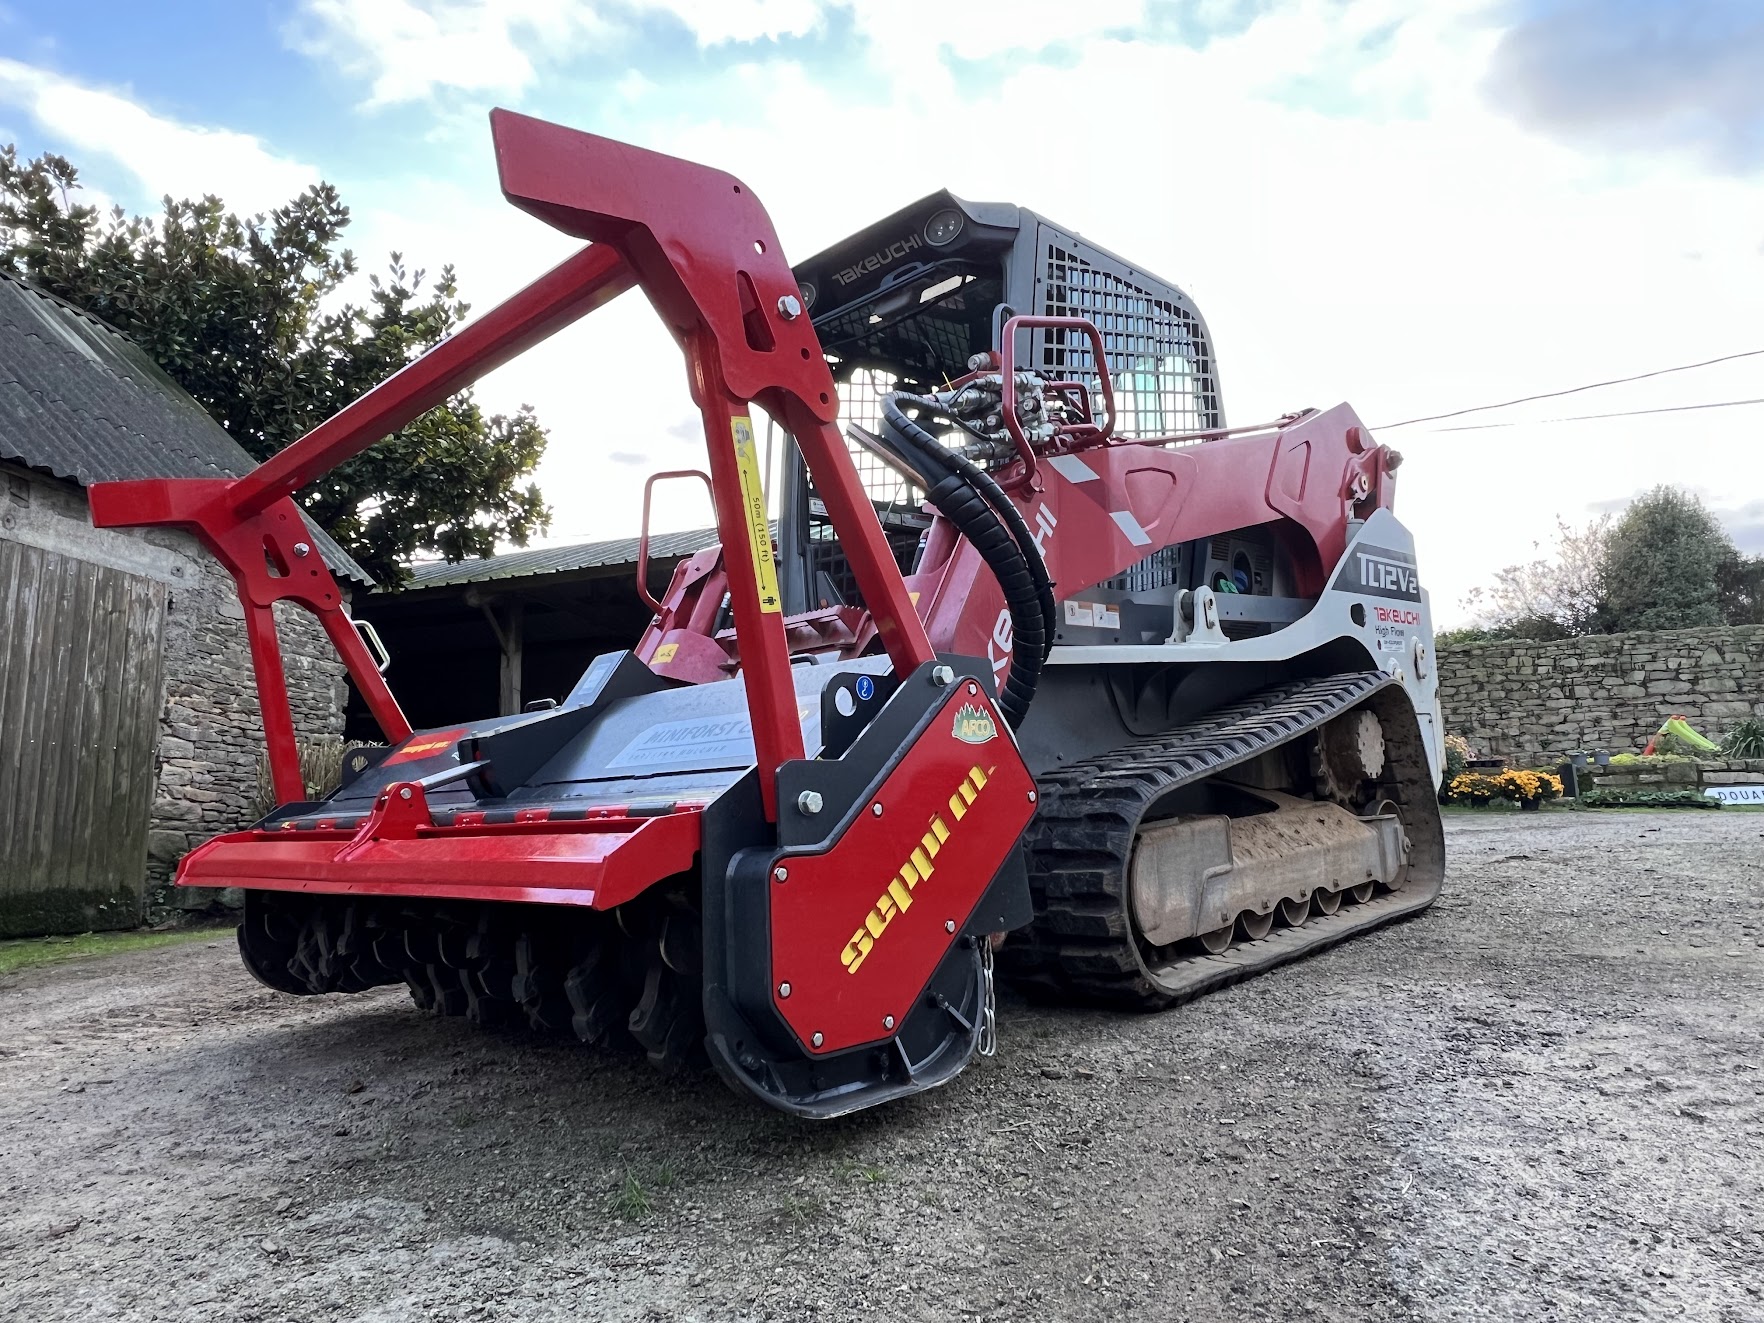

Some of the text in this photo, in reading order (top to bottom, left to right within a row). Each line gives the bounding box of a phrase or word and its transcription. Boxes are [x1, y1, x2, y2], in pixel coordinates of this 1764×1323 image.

[752, 497, 770, 563] 50m (150 ft)
[1375, 625, 1390, 638] High
[961, 719, 991, 737] AFCO
[1717, 790, 1764, 801] DOUA
[840, 811, 951, 975] seppi
